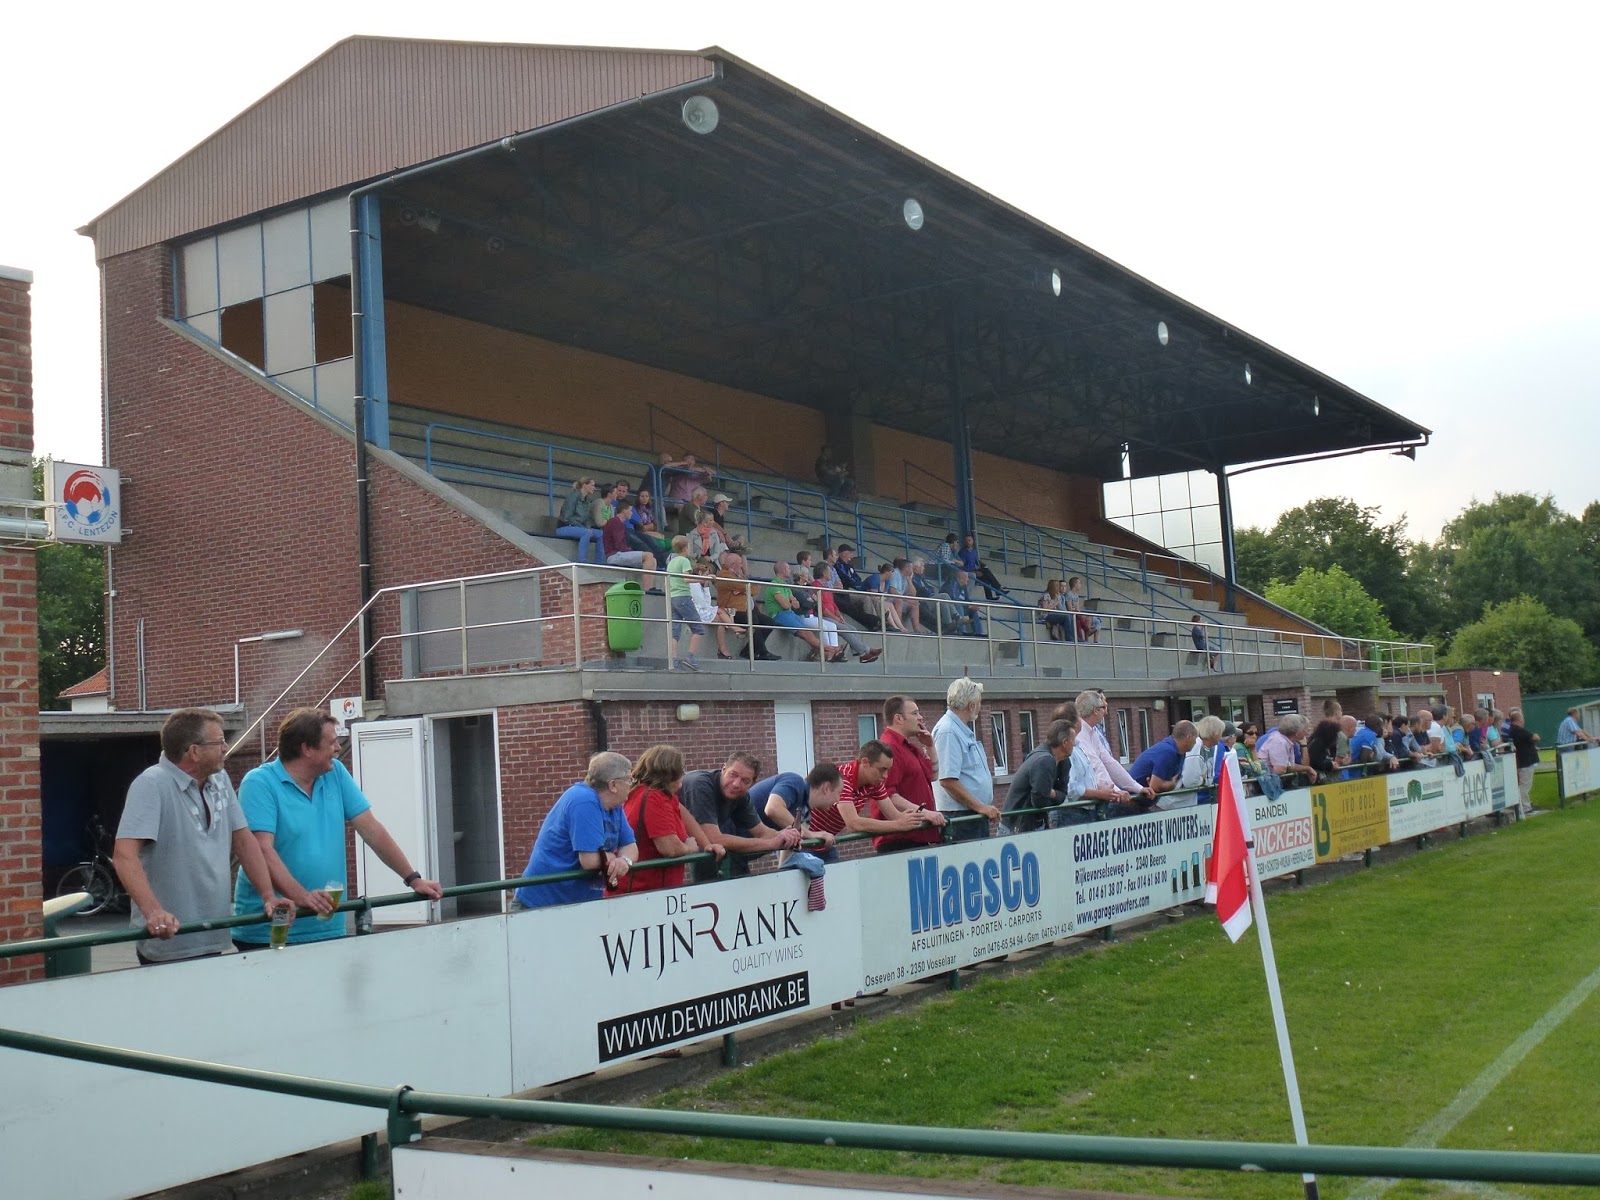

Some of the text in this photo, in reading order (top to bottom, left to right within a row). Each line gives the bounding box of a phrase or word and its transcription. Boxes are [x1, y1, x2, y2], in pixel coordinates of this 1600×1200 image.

[79, 510, 118, 536] LENTEZON
[1462, 772, 1489, 809] CLICK
[1255, 803, 1288, 821] BANDEN
[1073, 813, 1210, 863] GARAGE CARROSSERIE WOUTERS bvba
[1125, 859, 1130, 873] 6
[1135, 856, 1149, 870] 2340
[1149, 854, 1167, 867] Beerse
[907, 842, 1041, 935] MaesCo
[1075, 890, 1086, 905] Tel.
[1088, 887, 1099, 901] 014
[1127, 879, 1136, 892] Fax
[1137, 876, 1147, 889] 014
[666, 893, 688, 915] DE
[1076, 895, 1150, 925] www.garagewouters.com
[911, 931, 965, 952] AFSLUITINGEN
[971, 920, 1003, 938] POORTEN
[1008, 910, 1042, 928] CARPORTS
[972, 947, 986, 957] Gsm
[1027, 932, 1040, 943] Gsm
[732, 943, 803, 974] QUALITY WINES
[865, 970, 895, 987] Osseven
[896, 966, 905, 977] 38
[910, 961, 925, 976] 2350
[926, 955, 956, 971] Vosselaar
[603, 978, 806, 1054] WWW.DEWIJNRANK.BE
